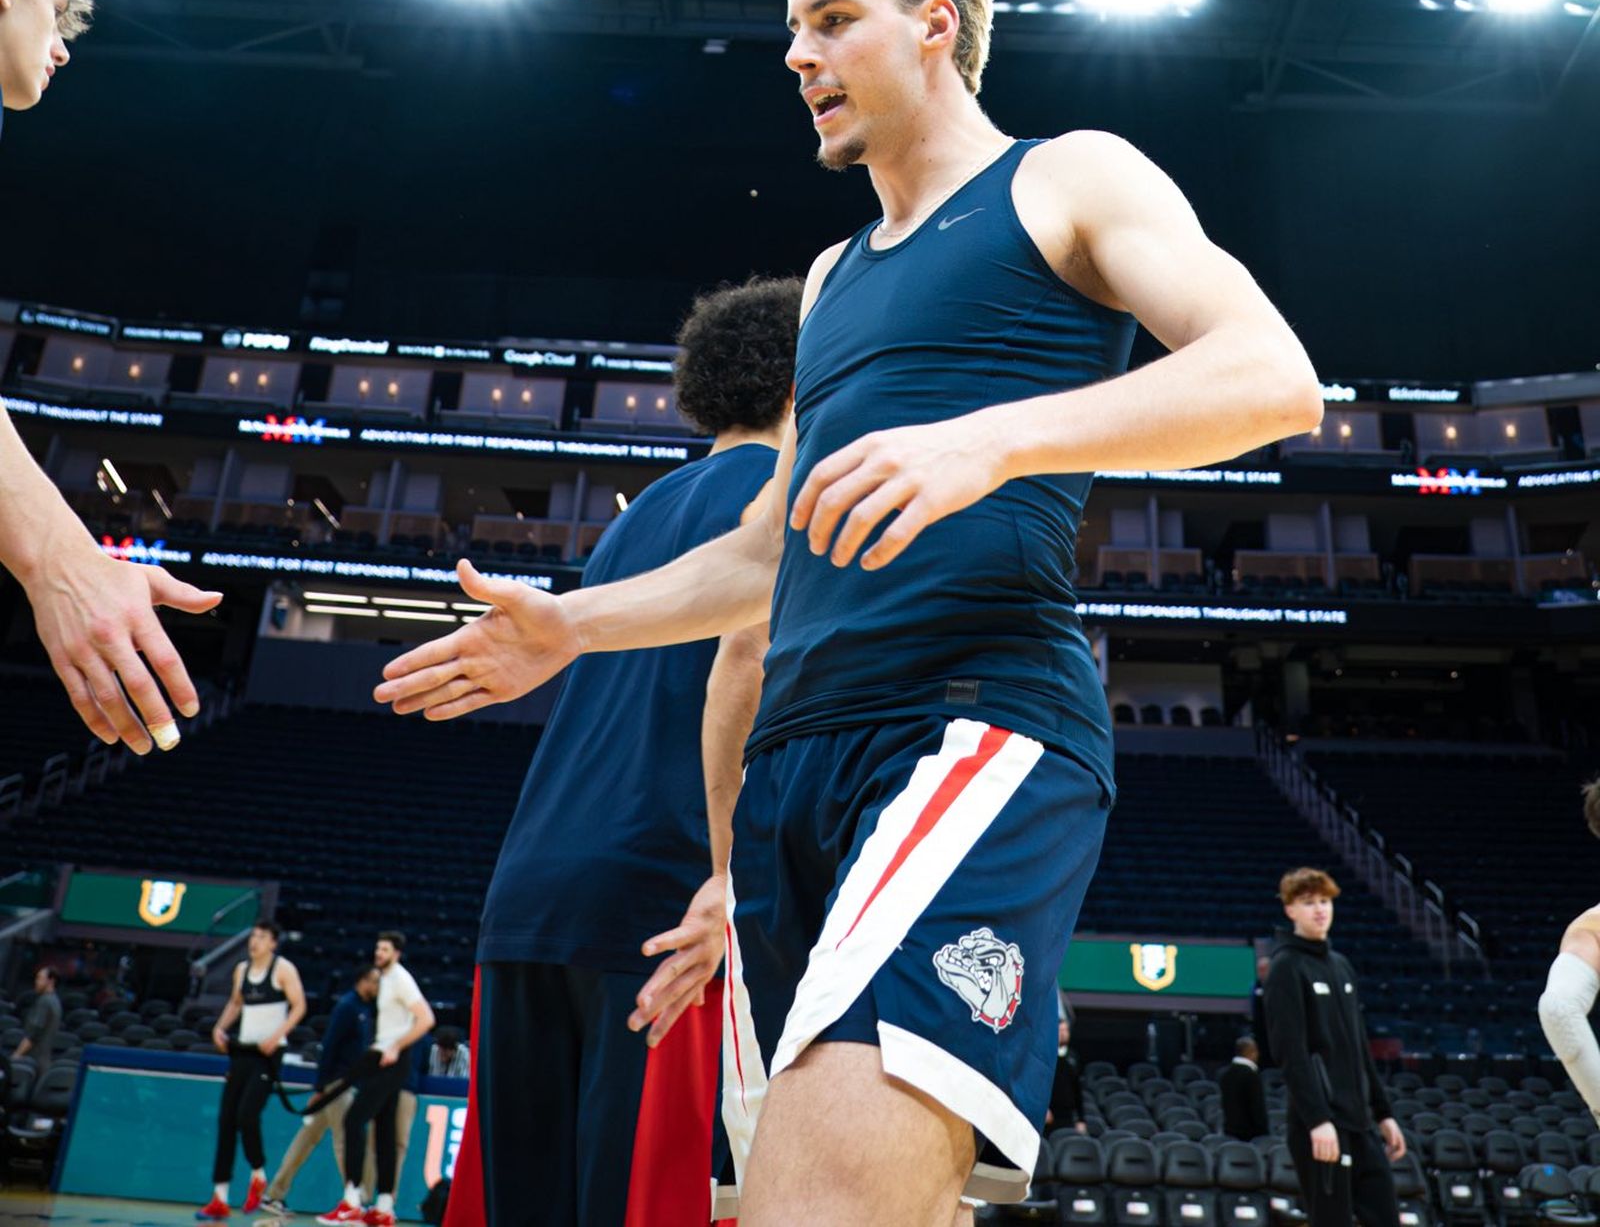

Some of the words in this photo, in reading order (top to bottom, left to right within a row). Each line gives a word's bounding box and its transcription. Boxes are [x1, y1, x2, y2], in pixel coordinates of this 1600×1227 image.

[242, 332, 290, 351] PEPSI
[503, 349, 544, 366] Google
[544, 352, 576, 366] Cloud
[1388, 386, 1459, 402] ticketmaster
[39, 403, 108, 422] THROUGHOUT
[109, 410, 129, 423] THE
[130, 412, 163, 427] STATE
[360, 428, 429, 445] ADVOCATING
[430, 433, 454, 446] FOR
[454, 434, 484, 447] FIRST
[485, 436, 555, 452] RESPONDERS
[556, 440, 630, 456] THROUGHOUT
[630, 445, 652, 458] THE
[653, 446, 688, 460] STATE
[1223, 471, 1245, 483] THE
[1246, 471, 1282, 484] STATE
[1518, 470, 1592, 487] ADVOCATING
[202, 551, 276, 569] ADVOCATING
[277, 557, 301, 570] FOR
[302, 559, 334, 573] FIRST
[334, 561, 410, 580] RESPONDERS
[1088, 604, 1122, 616] FIRST
[1123, 604, 1201, 619] RESPONDERS
[1202, 606, 1283, 621] THROUGHOUT
[1284, 609, 1307, 622] THE
[1308, 610, 1347, 623] STATE
